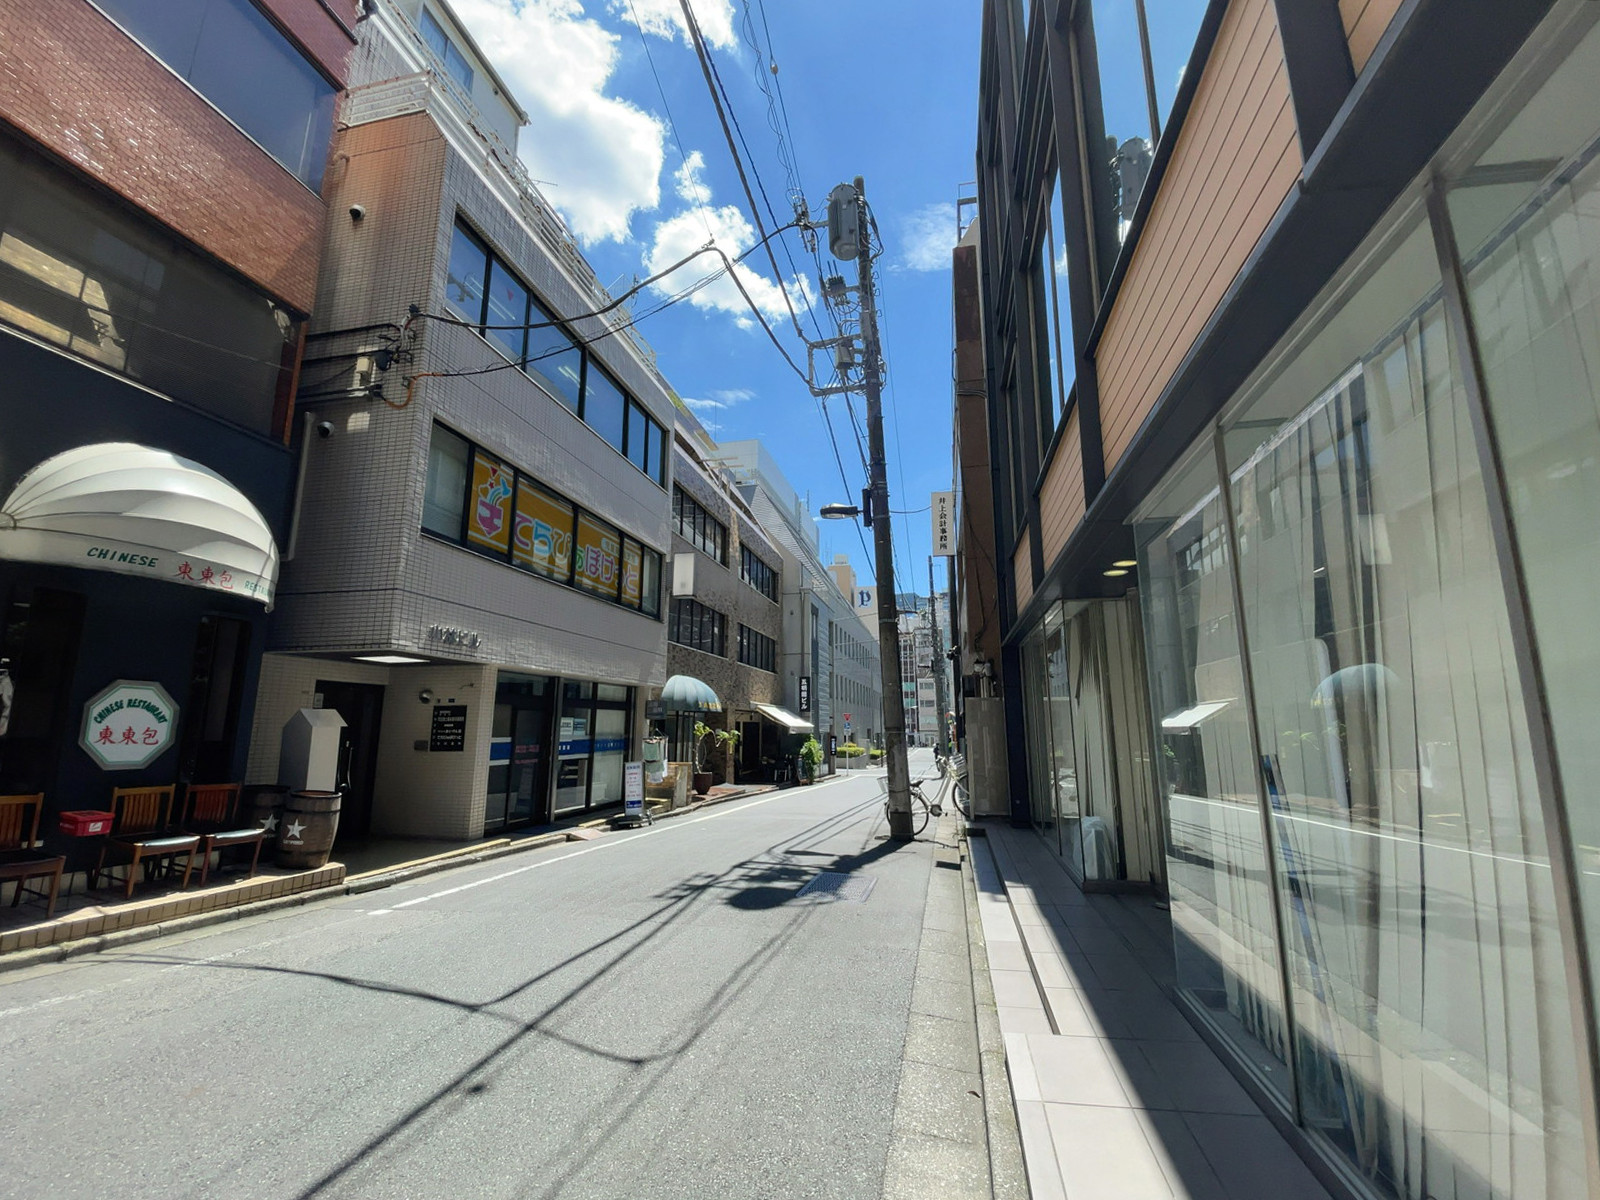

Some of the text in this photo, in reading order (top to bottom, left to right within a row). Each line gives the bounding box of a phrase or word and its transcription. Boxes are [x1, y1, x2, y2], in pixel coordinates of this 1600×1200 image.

[87, 547, 159, 568] CHINESE
[174, 561, 234, 590] 東東包
[94, 698, 168, 724] CHINESE RESTAURANT
[94, 725, 159, 746] 東東包
